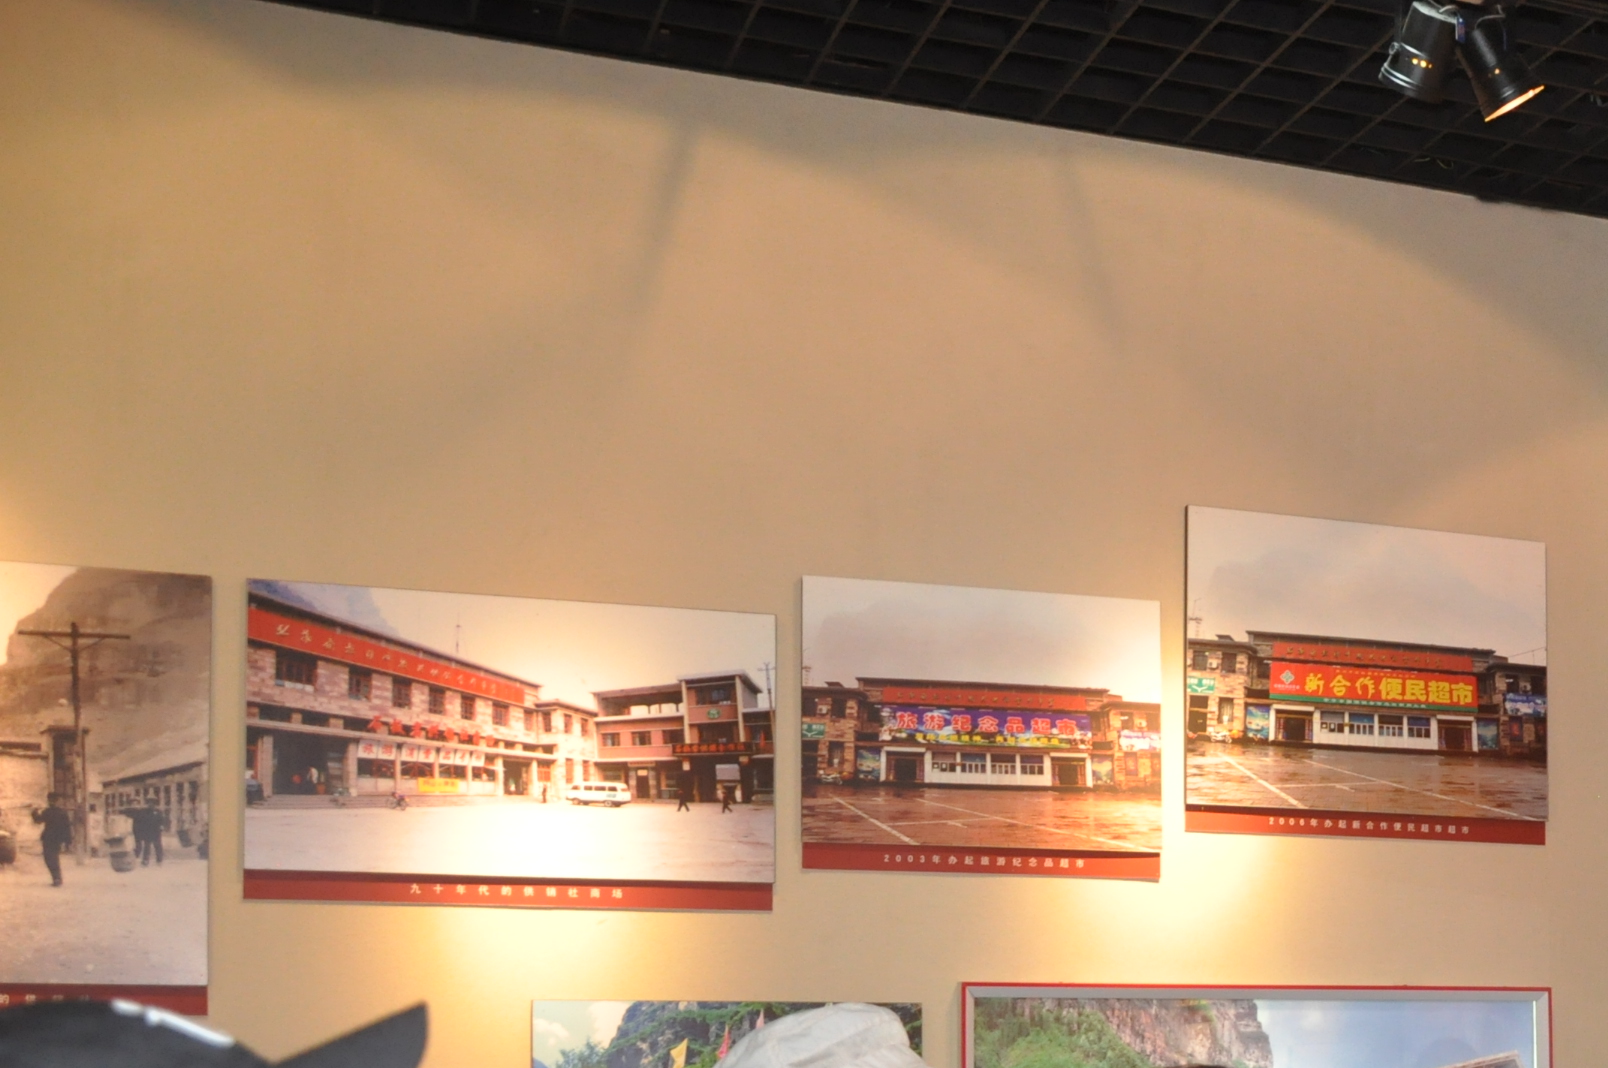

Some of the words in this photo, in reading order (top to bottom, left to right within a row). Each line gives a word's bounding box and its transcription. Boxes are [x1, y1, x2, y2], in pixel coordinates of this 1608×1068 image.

[1304, 672, 1474, 706] 新合作便民超市
[896, 711, 1078, 736] 旅游纪念品超市
[883, 853, 1085, 869] 2003年办起旅游纪念品超市
[410, 883, 623, 899] 九十年代的供销社商场
